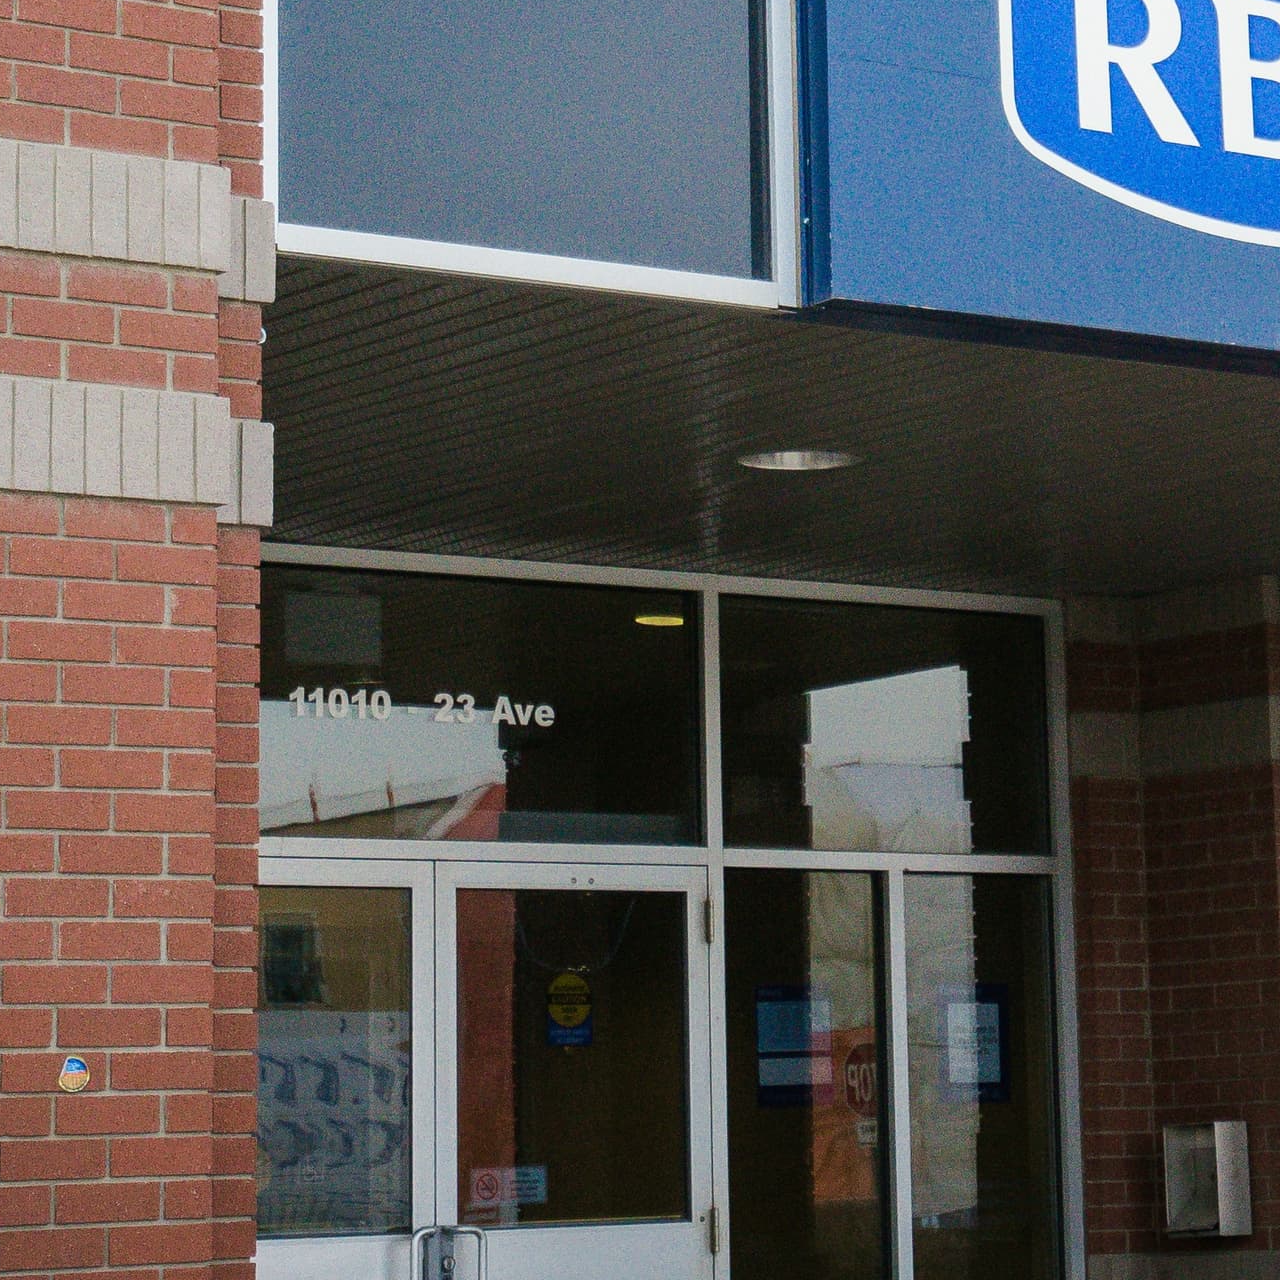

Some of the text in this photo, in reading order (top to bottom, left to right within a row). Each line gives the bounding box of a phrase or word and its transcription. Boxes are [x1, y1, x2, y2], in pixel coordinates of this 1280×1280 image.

[289, 686, 392, 720] 11010
[433, 693, 476, 723] 23
[492, 696, 555, 727] Ave
